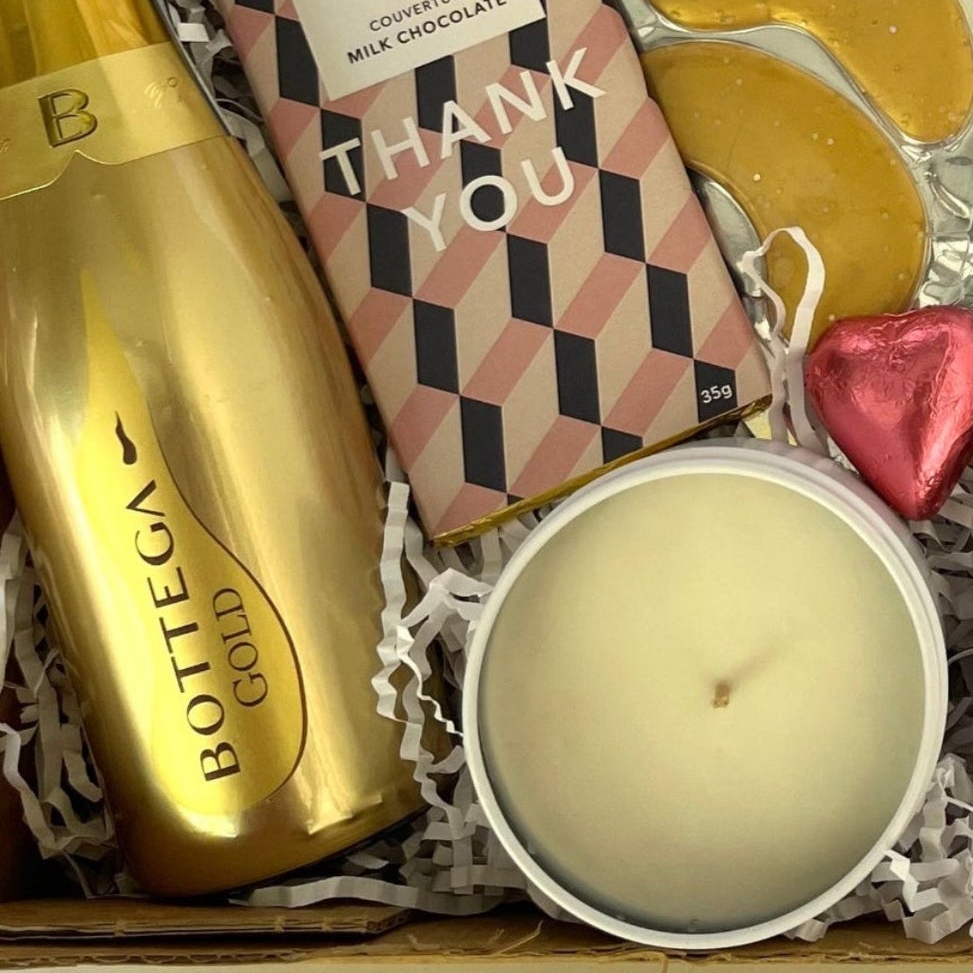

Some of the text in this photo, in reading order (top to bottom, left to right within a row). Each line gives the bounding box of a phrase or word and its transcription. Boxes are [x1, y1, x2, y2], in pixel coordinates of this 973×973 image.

[347, 37, 393, 64] MILK
[37, 88, 98, 148] B
[319, 47, 608, 196] THANK
[401, 146, 575, 252] YOU
[700, 384, 733, 404] 35g
[125, 479, 241, 782] BOTTEGA
[212, 587, 269, 708] GOLD
